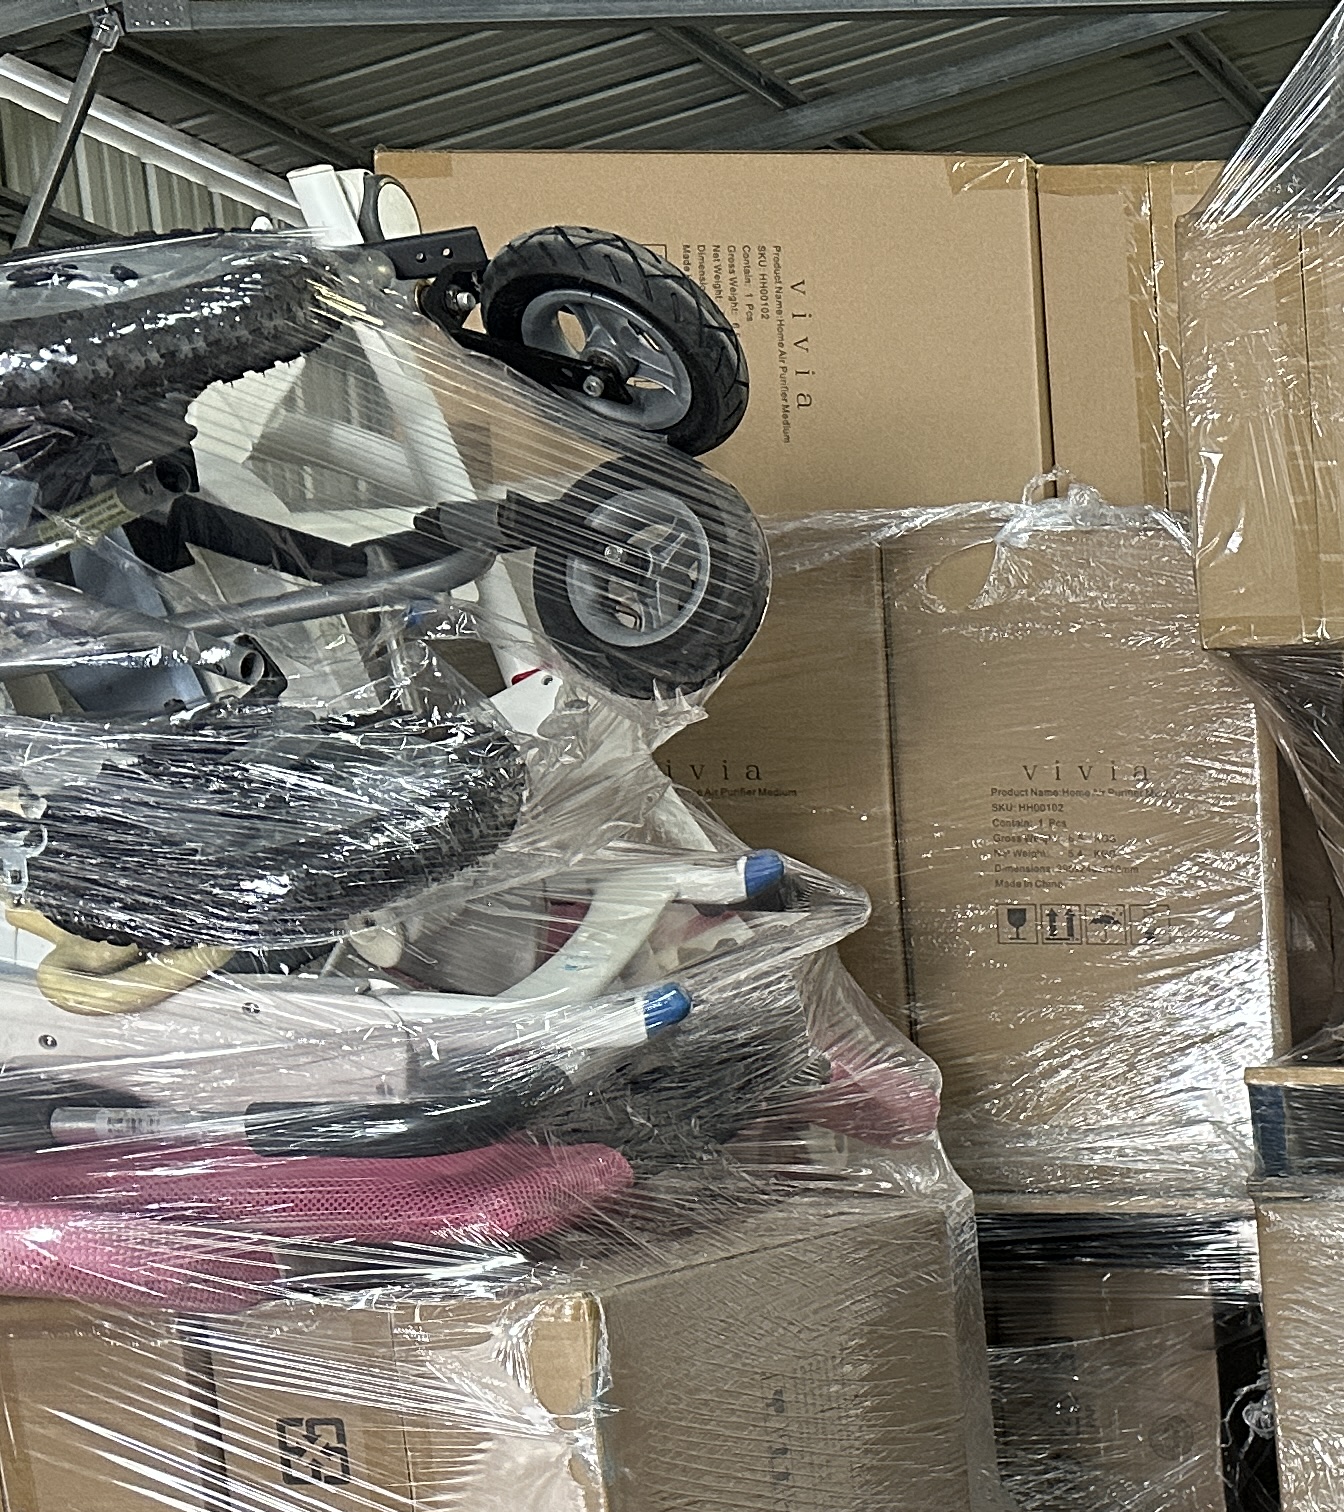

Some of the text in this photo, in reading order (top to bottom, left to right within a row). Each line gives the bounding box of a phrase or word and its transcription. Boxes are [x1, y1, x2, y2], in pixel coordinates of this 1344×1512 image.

[712, 245, 721, 263] Net
[728, 246, 736, 276] Gross
[759, 274, 769, 319] HH00102
[773, 245, 790, 443] Product Air Purifier Medium
[790, 280, 815, 409] vivia
[1023, 760, 1148, 781] vivia
[991, 788, 1028, 797] Product
[1018, 803, 1064, 812] HH00102
